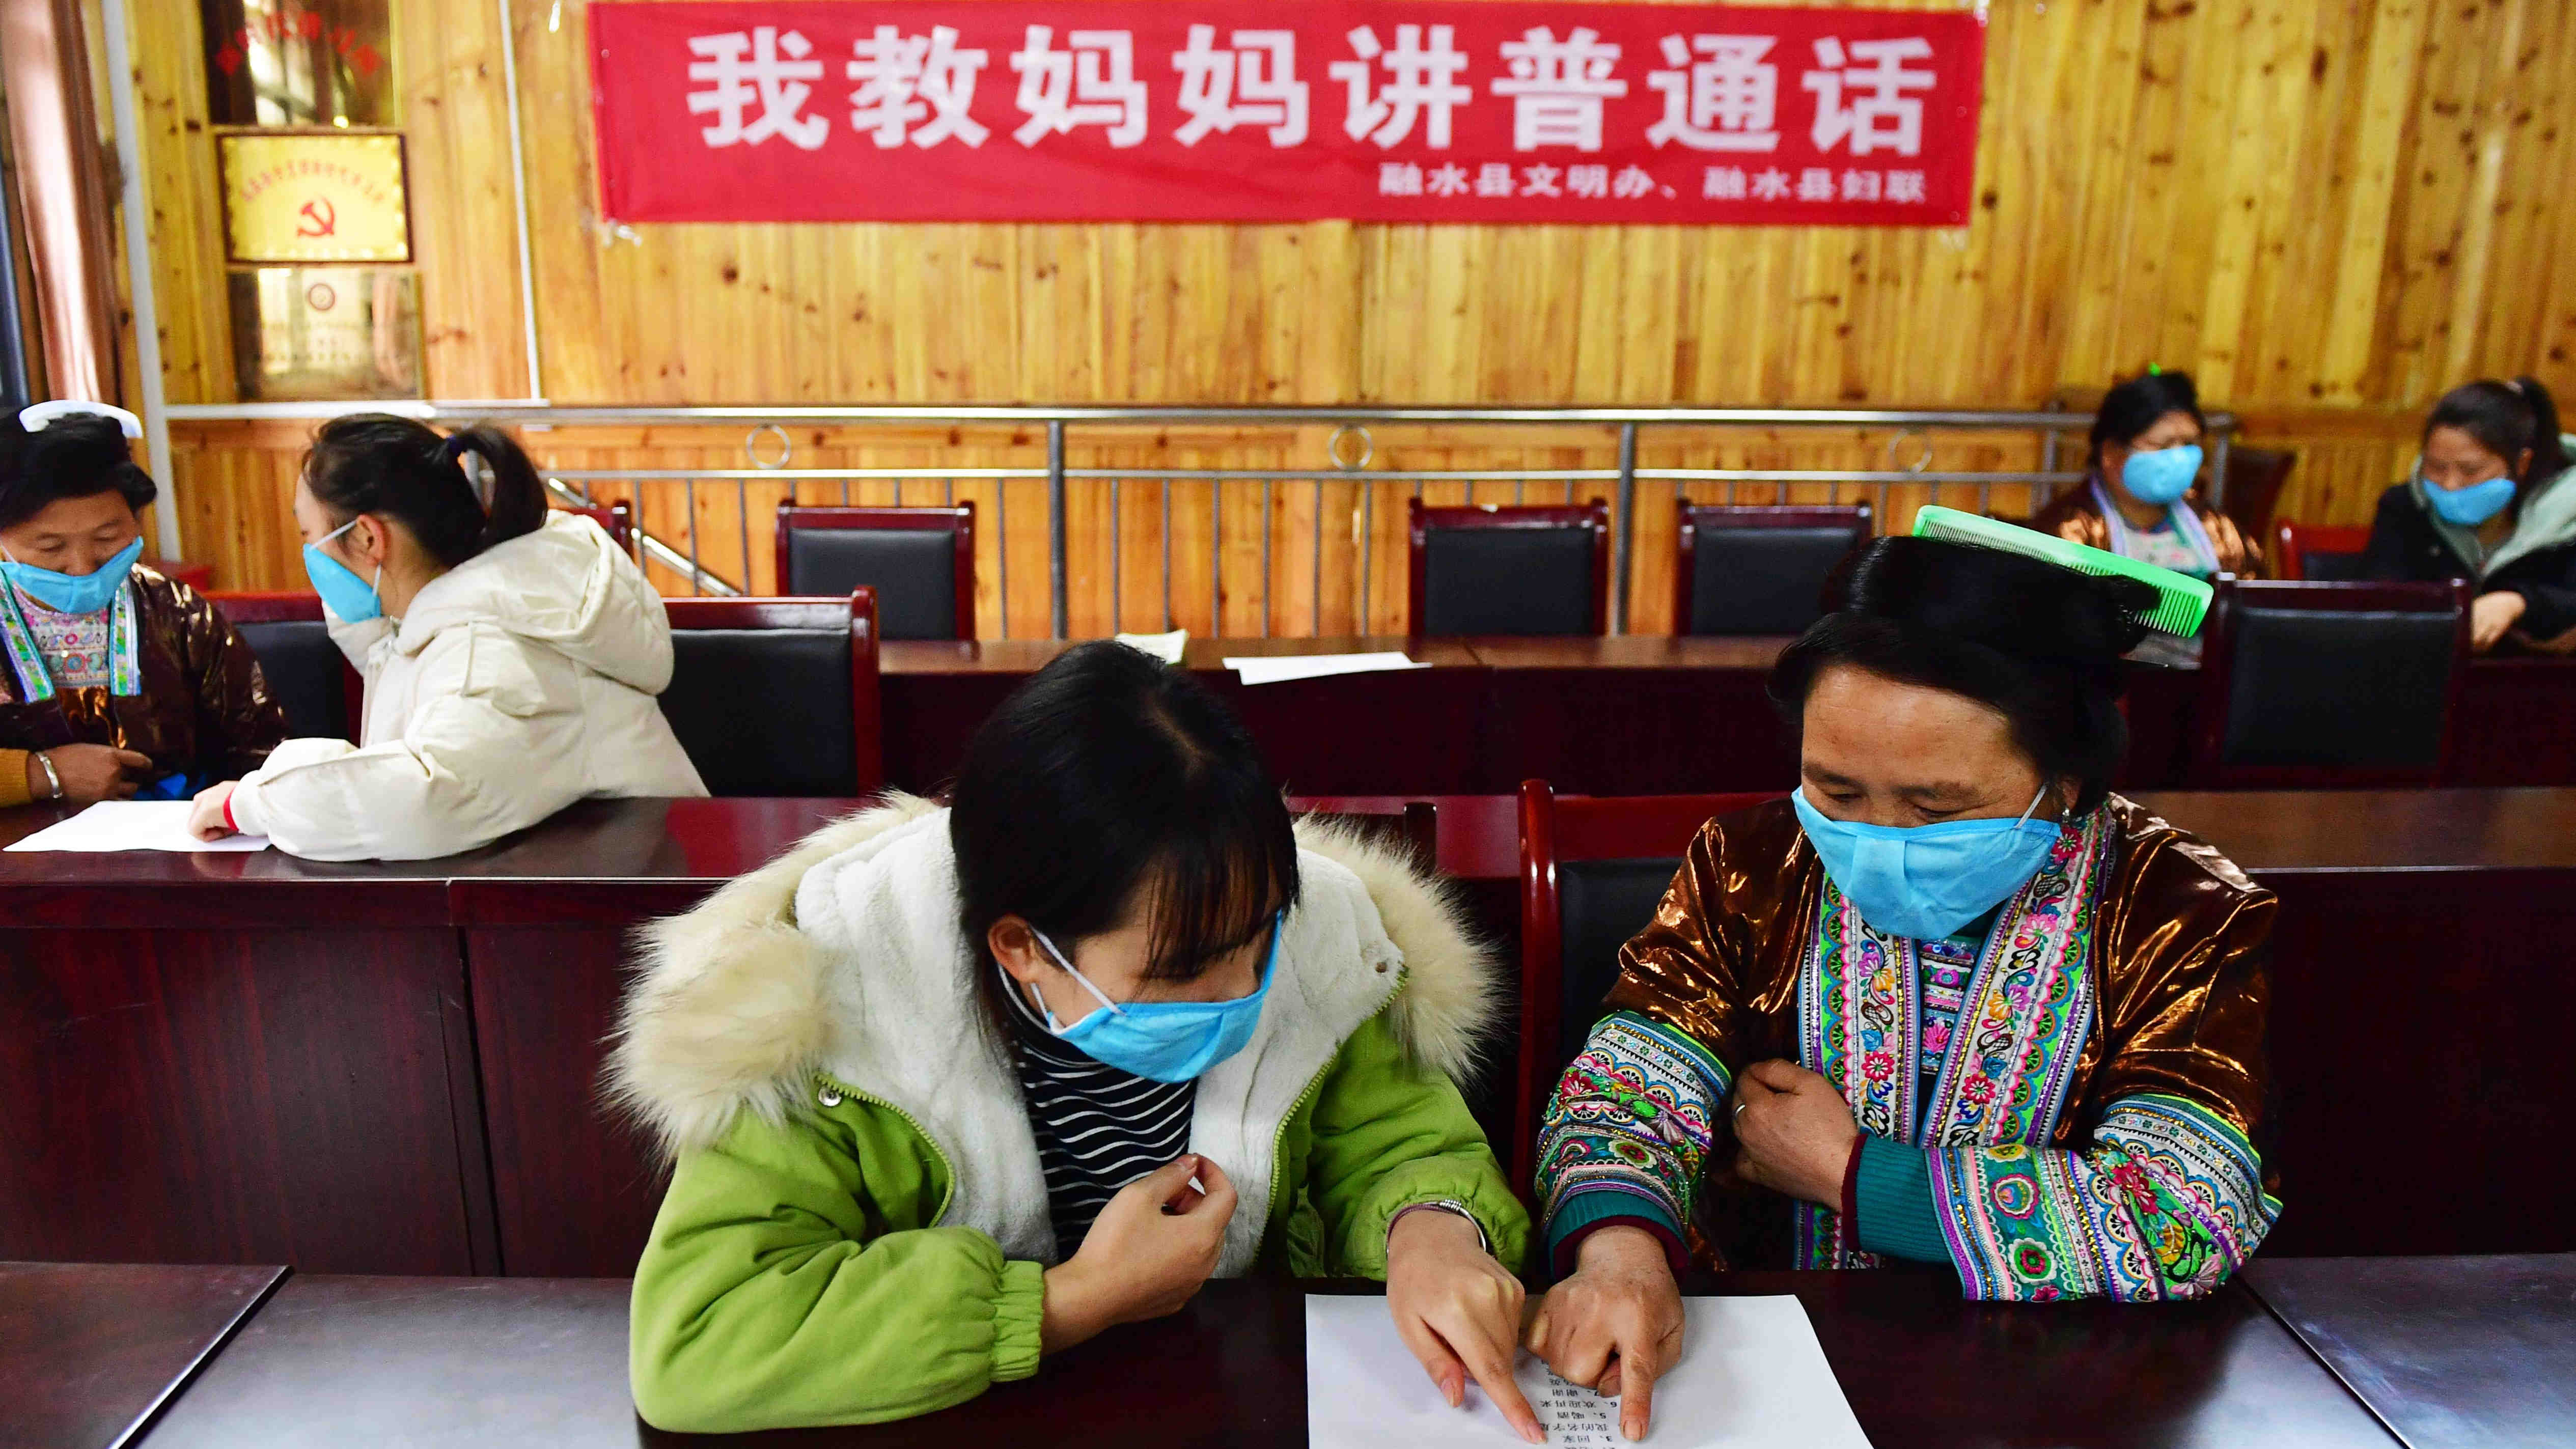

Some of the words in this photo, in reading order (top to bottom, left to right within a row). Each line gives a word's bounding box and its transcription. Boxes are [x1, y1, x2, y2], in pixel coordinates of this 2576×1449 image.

[686, 24, 1936, 156] 我教妈妈讲普通话
[1378, 162, 1927, 205] 融水县文明办、融水县妇联
